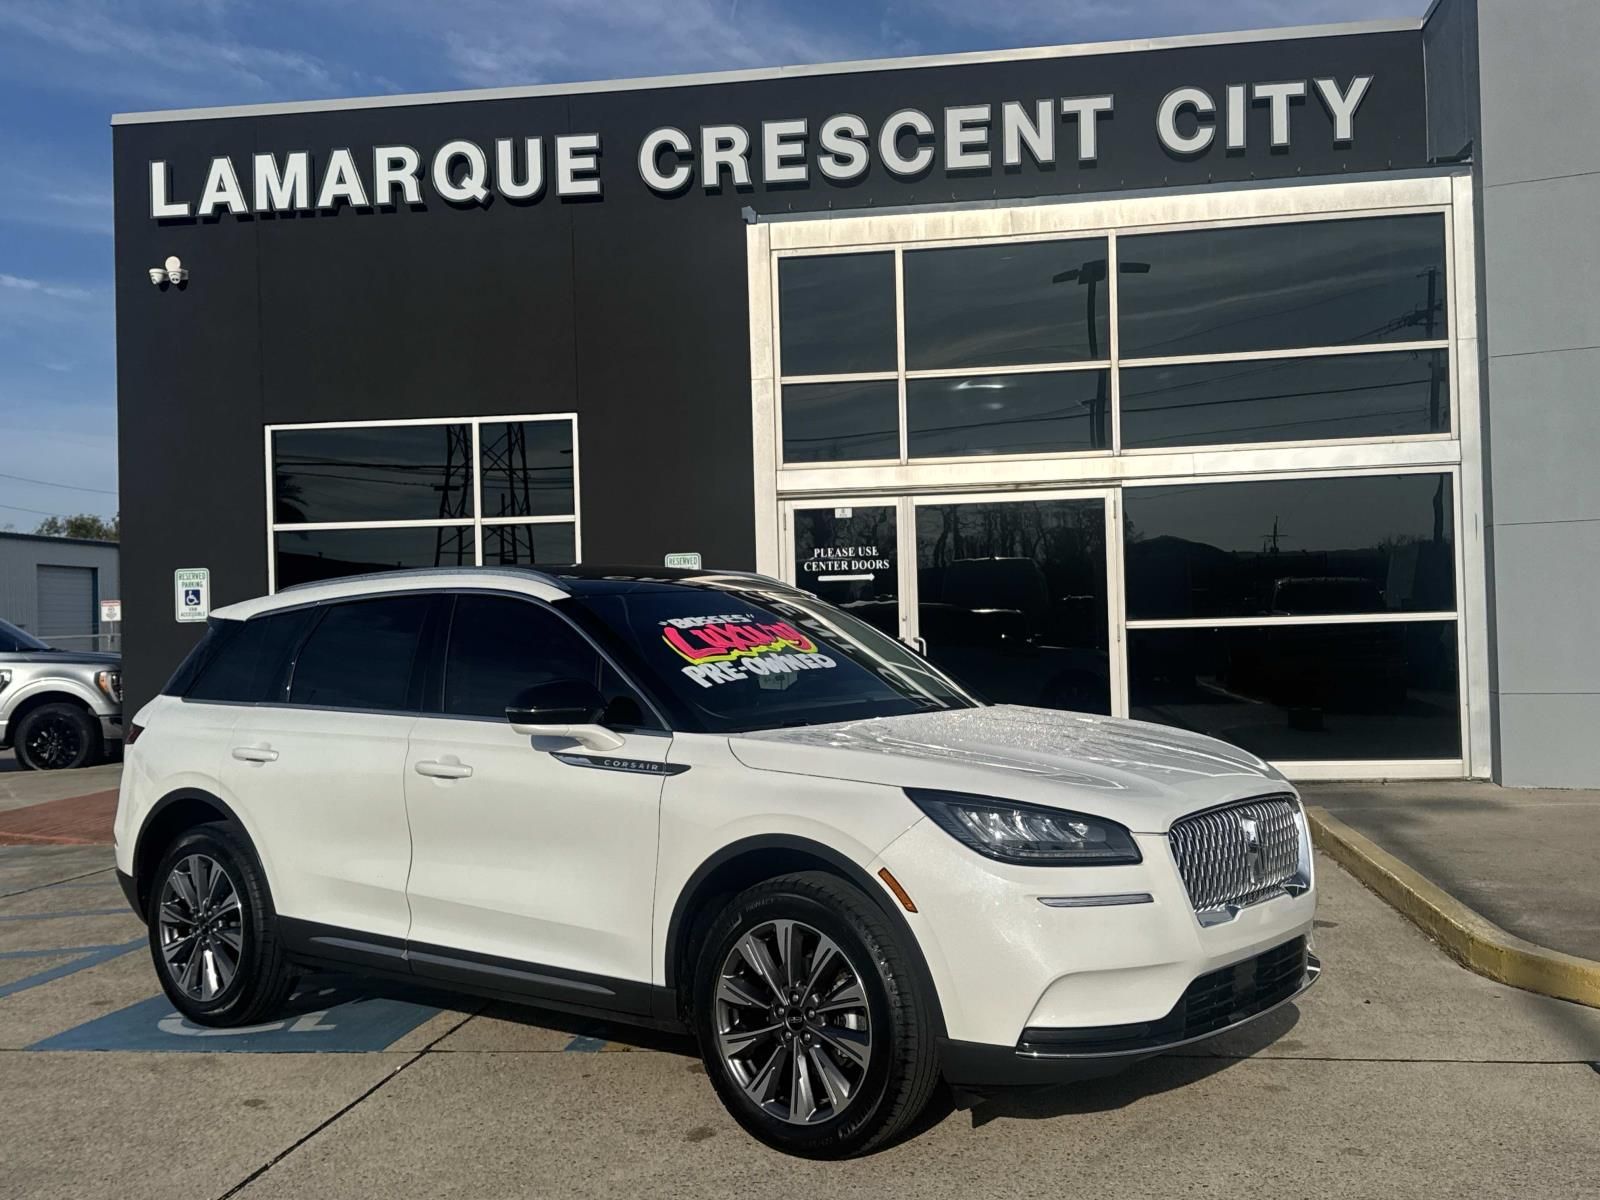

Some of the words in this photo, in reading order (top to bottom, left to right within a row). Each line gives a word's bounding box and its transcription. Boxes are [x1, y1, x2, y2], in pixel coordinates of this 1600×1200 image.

[150, 133, 601, 219] LAMARQUE
[638, 95, 1113, 193] CRESCENT
[1157, 75, 1374, 156] CITY
[814, 547, 856, 558] PLEASE
[858, 546, 880, 557] USE
[668, 556, 698, 566] RESERVED
[803, 561, 849, 571] CENTER
[851, 559, 890, 570] DOORS
[178, 572, 206, 581] RESERVED
[681, 653, 837, 688] PRE-OWNED
[604, 760, 658, 770] CORSAIR
